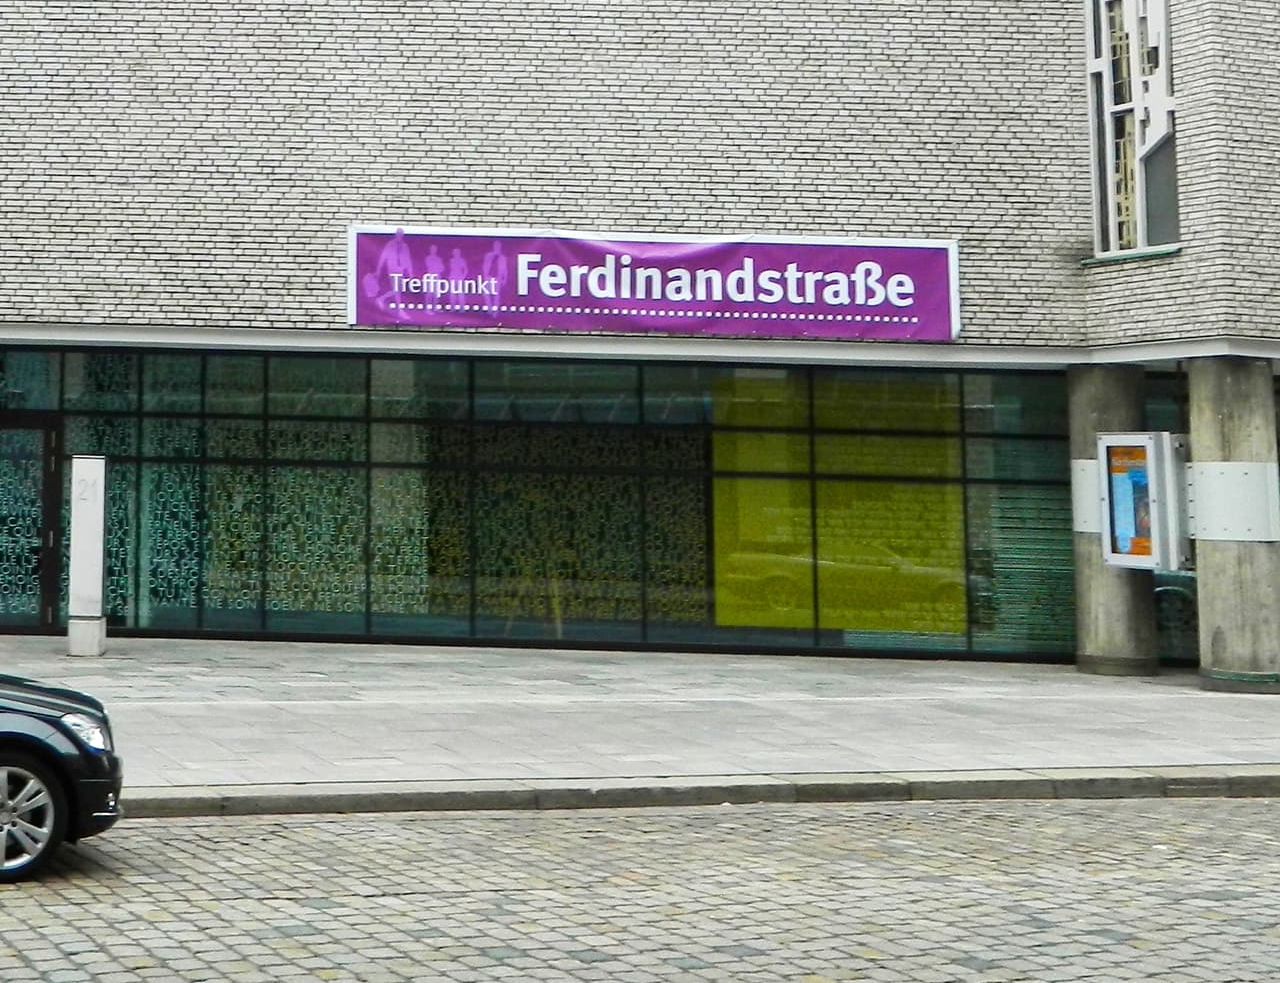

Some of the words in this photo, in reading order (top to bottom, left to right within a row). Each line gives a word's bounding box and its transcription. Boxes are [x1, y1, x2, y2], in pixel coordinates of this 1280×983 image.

[389, 271, 499, 302] Treffpunkt
[517, 253, 915, 308] Ferdinandstraße
[77, 478, 99, 503] 21
